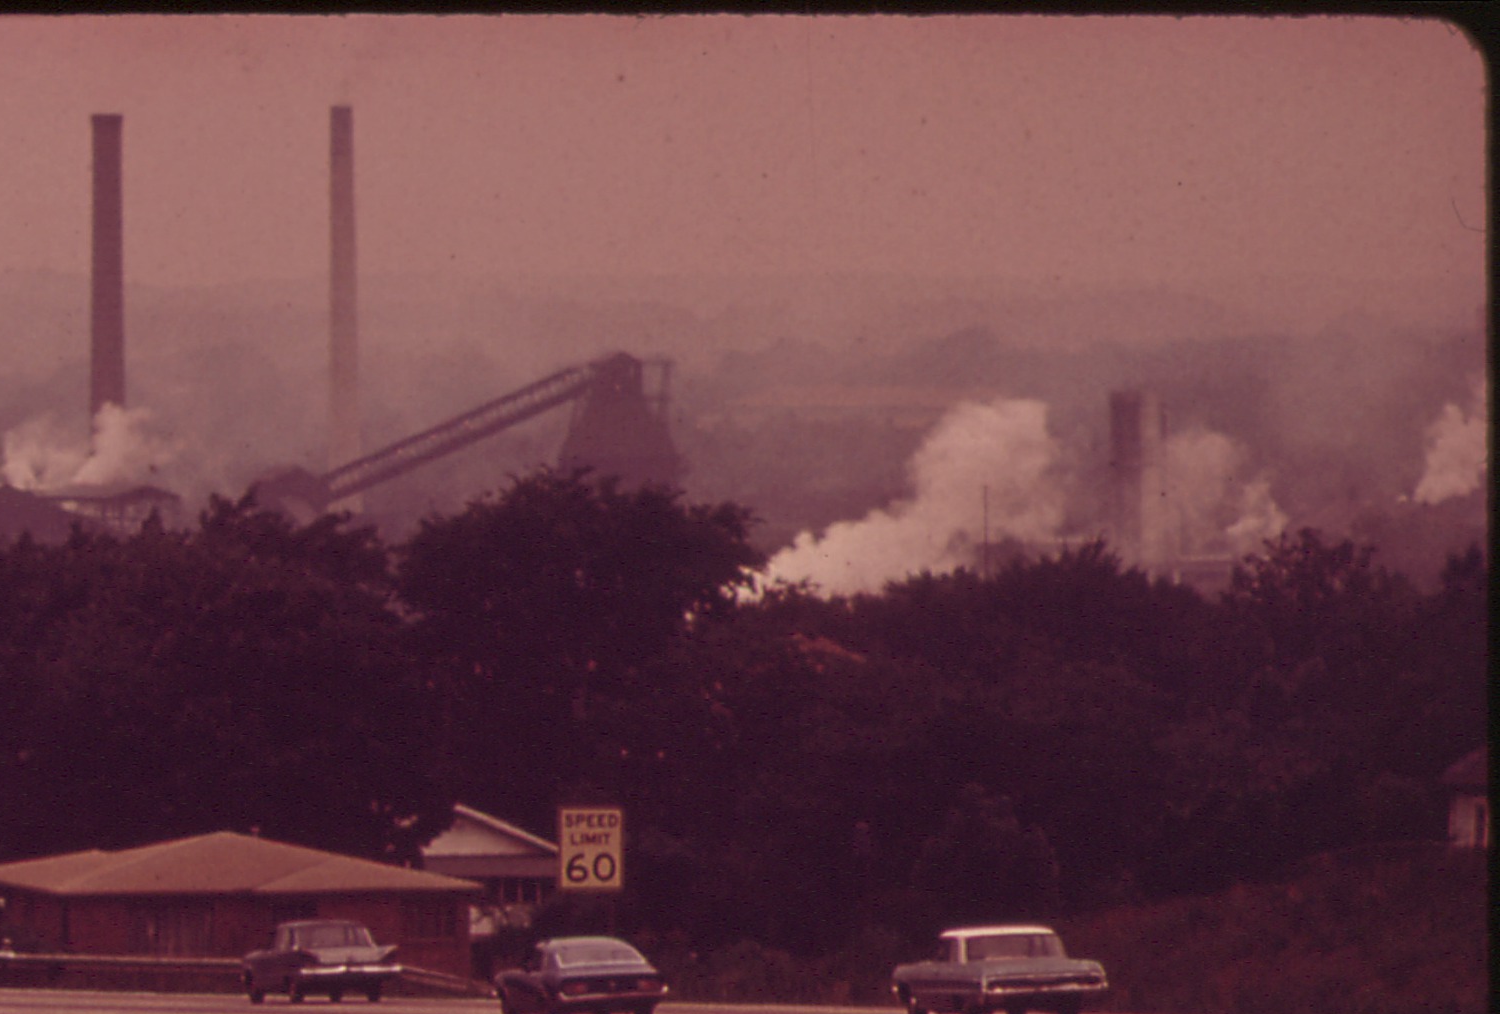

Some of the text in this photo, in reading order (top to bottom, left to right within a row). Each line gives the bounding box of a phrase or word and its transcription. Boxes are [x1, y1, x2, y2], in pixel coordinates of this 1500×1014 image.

[565, 813, 618, 828] SPEED
[570, 833, 610, 846] LIMIT
[566, 852, 616, 883] 60
